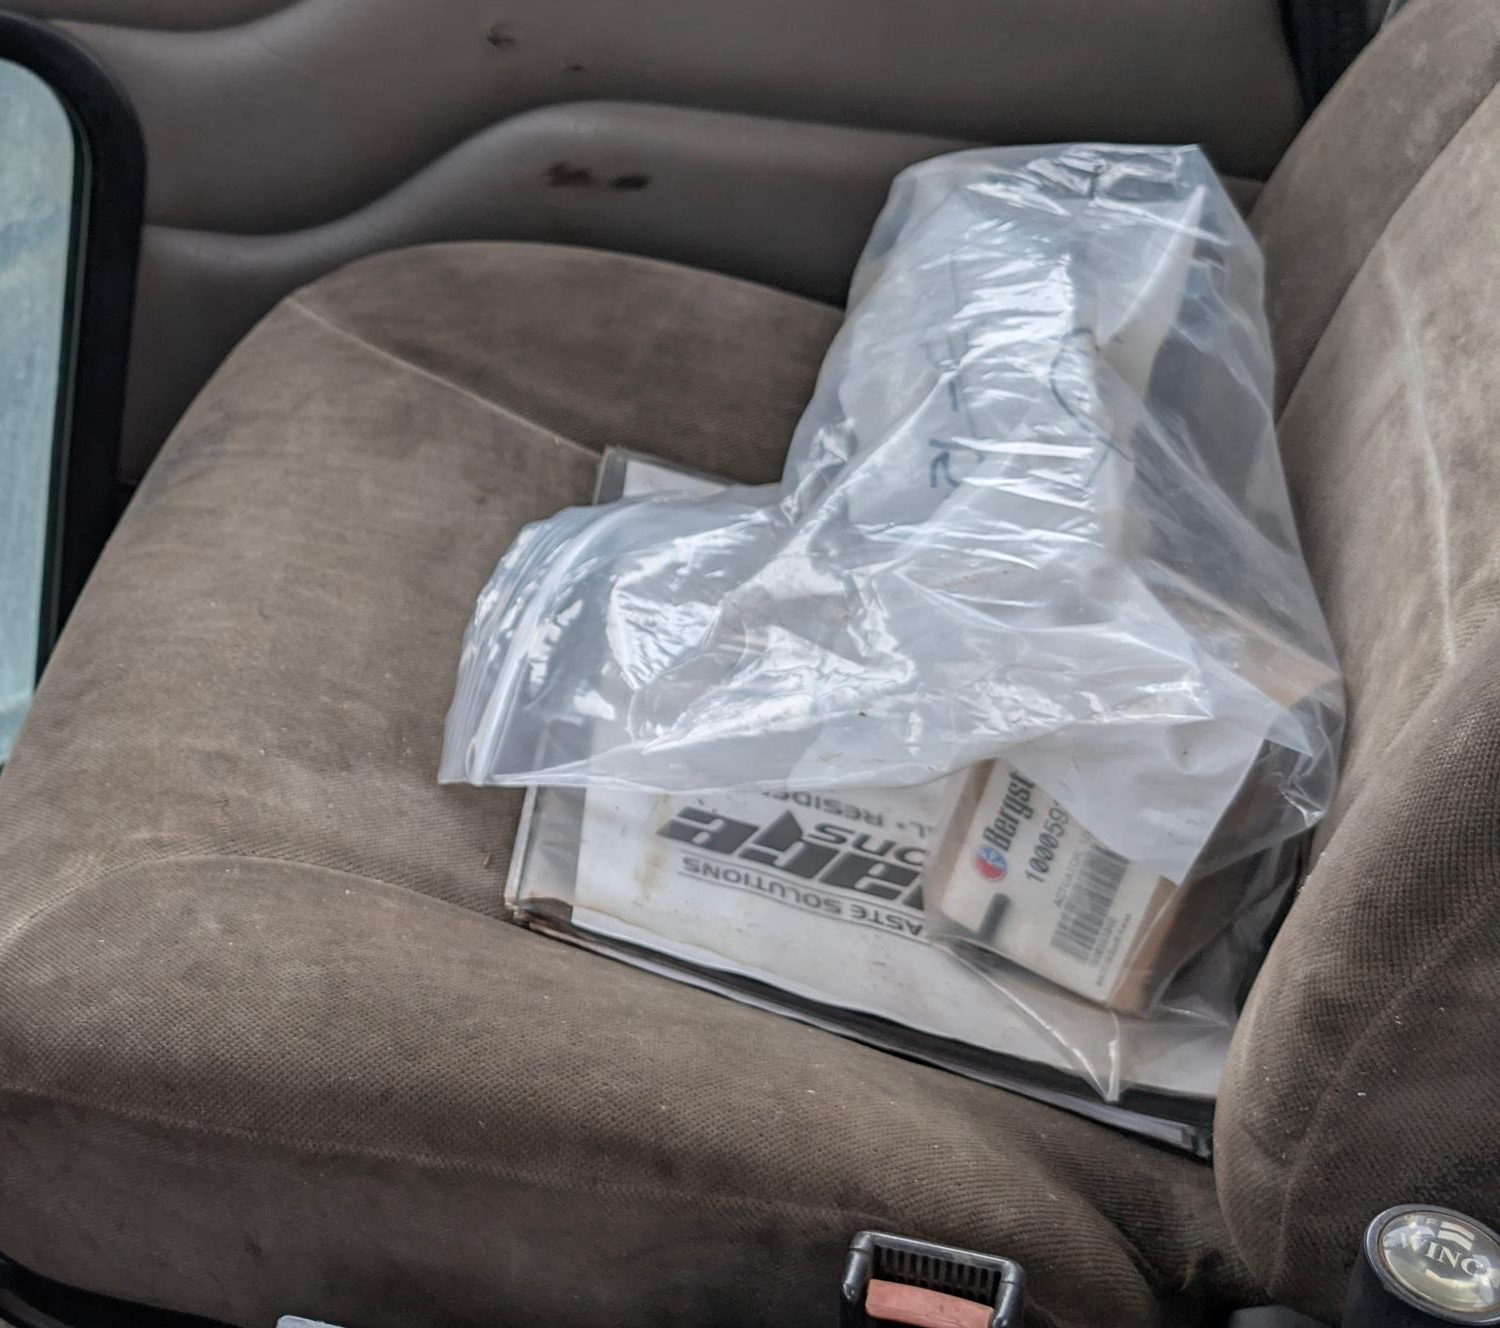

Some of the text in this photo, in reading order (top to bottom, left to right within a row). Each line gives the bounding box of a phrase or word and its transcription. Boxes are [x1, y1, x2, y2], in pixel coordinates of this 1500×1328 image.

[762, 791, 885, 826] RESIDE
[1025, 799, 1071, 884] 100059
[682, 856, 843, 914] SOLUTIONS
